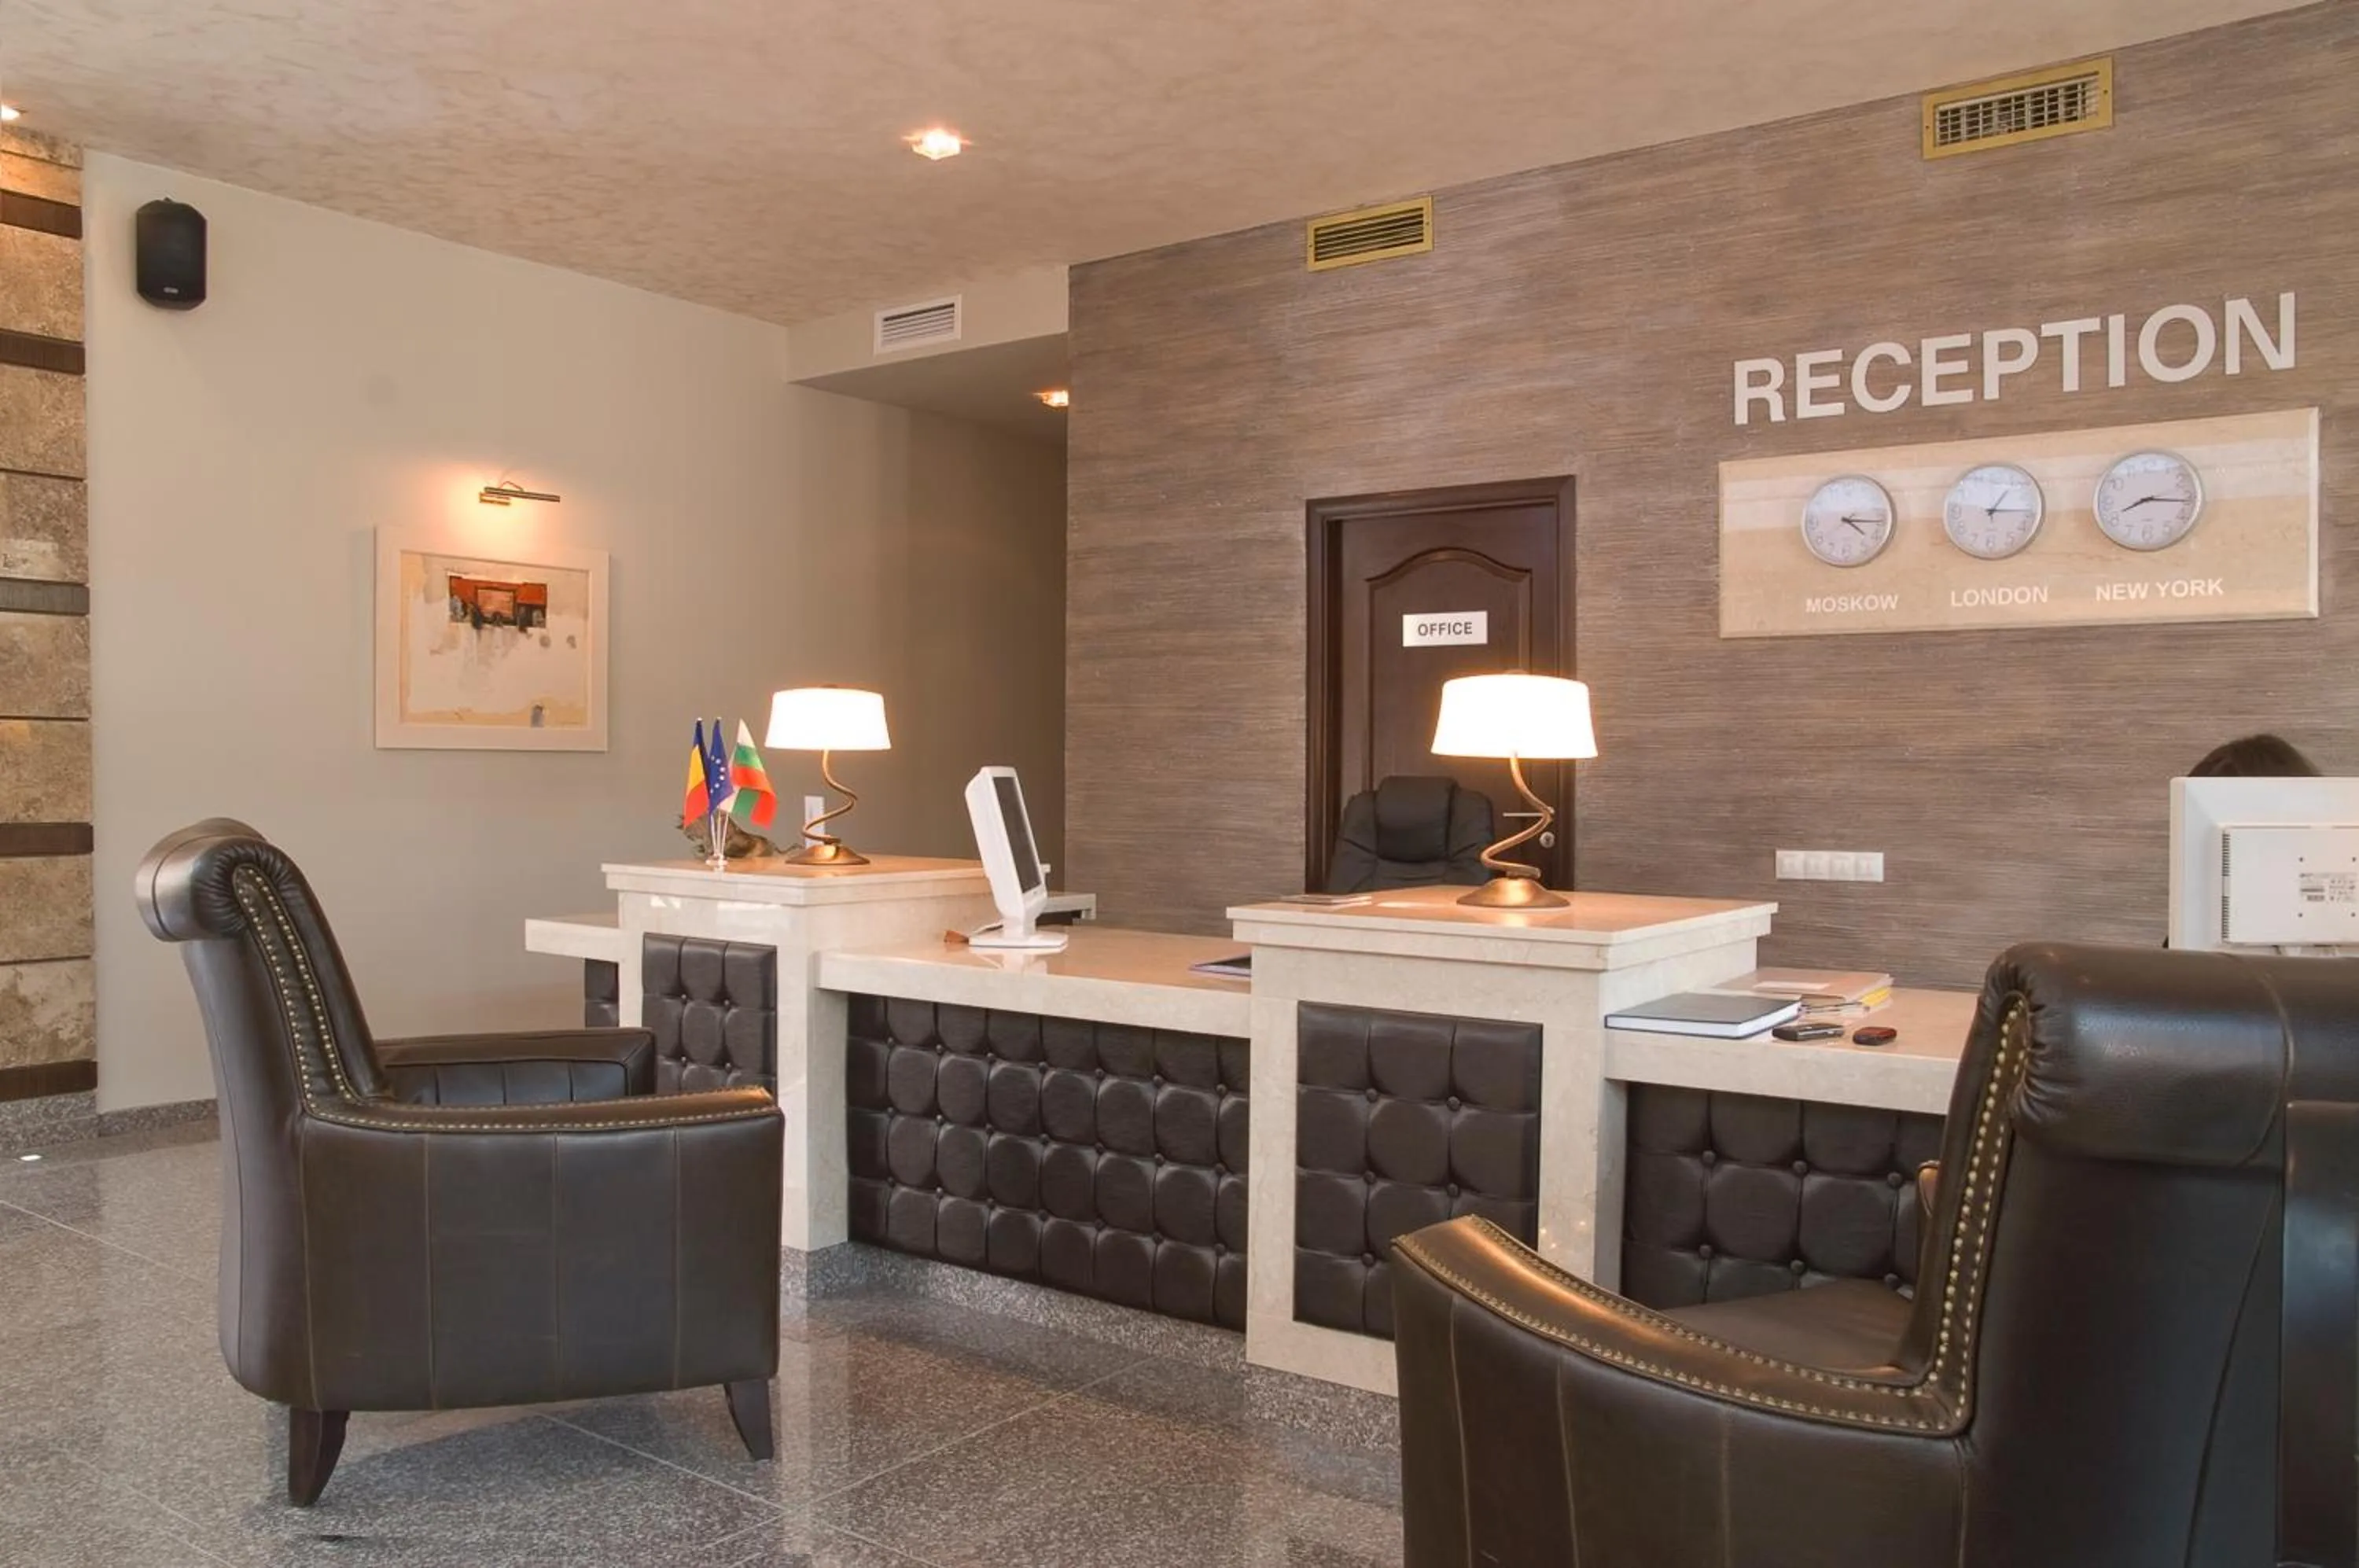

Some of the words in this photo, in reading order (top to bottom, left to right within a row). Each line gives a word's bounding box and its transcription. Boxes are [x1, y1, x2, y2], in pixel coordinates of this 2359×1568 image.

[1733, 292, 2295, 425] RECEPTION
[1950, 585, 2048, 607] LONDON
[2096, 582, 2149, 602] NEW
[2155, 577, 2224, 598] YORK
[1805, 594, 1899, 613] MOSKOW
[1417, 621, 1473, 636] OFFICE
